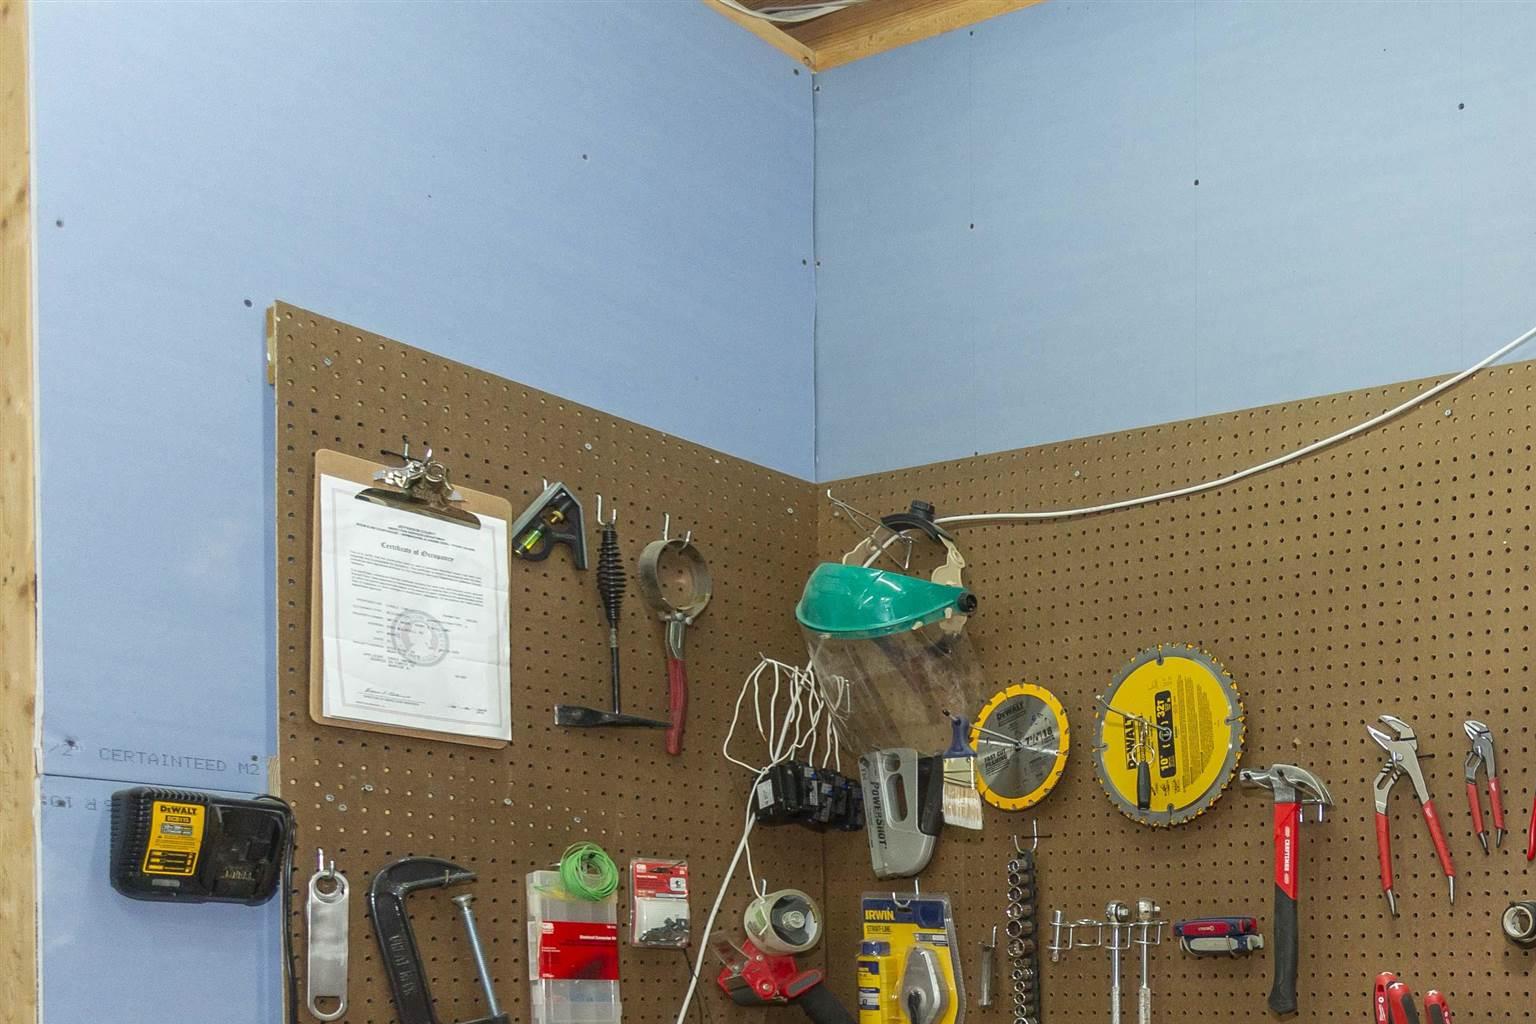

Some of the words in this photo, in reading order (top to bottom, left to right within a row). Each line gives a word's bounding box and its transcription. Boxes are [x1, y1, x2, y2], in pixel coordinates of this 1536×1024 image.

[99, 747, 227, 773] CERTAINTEED
[238, 762, 260, 776] M2
[865, 909, 895, 921] IRWIN
